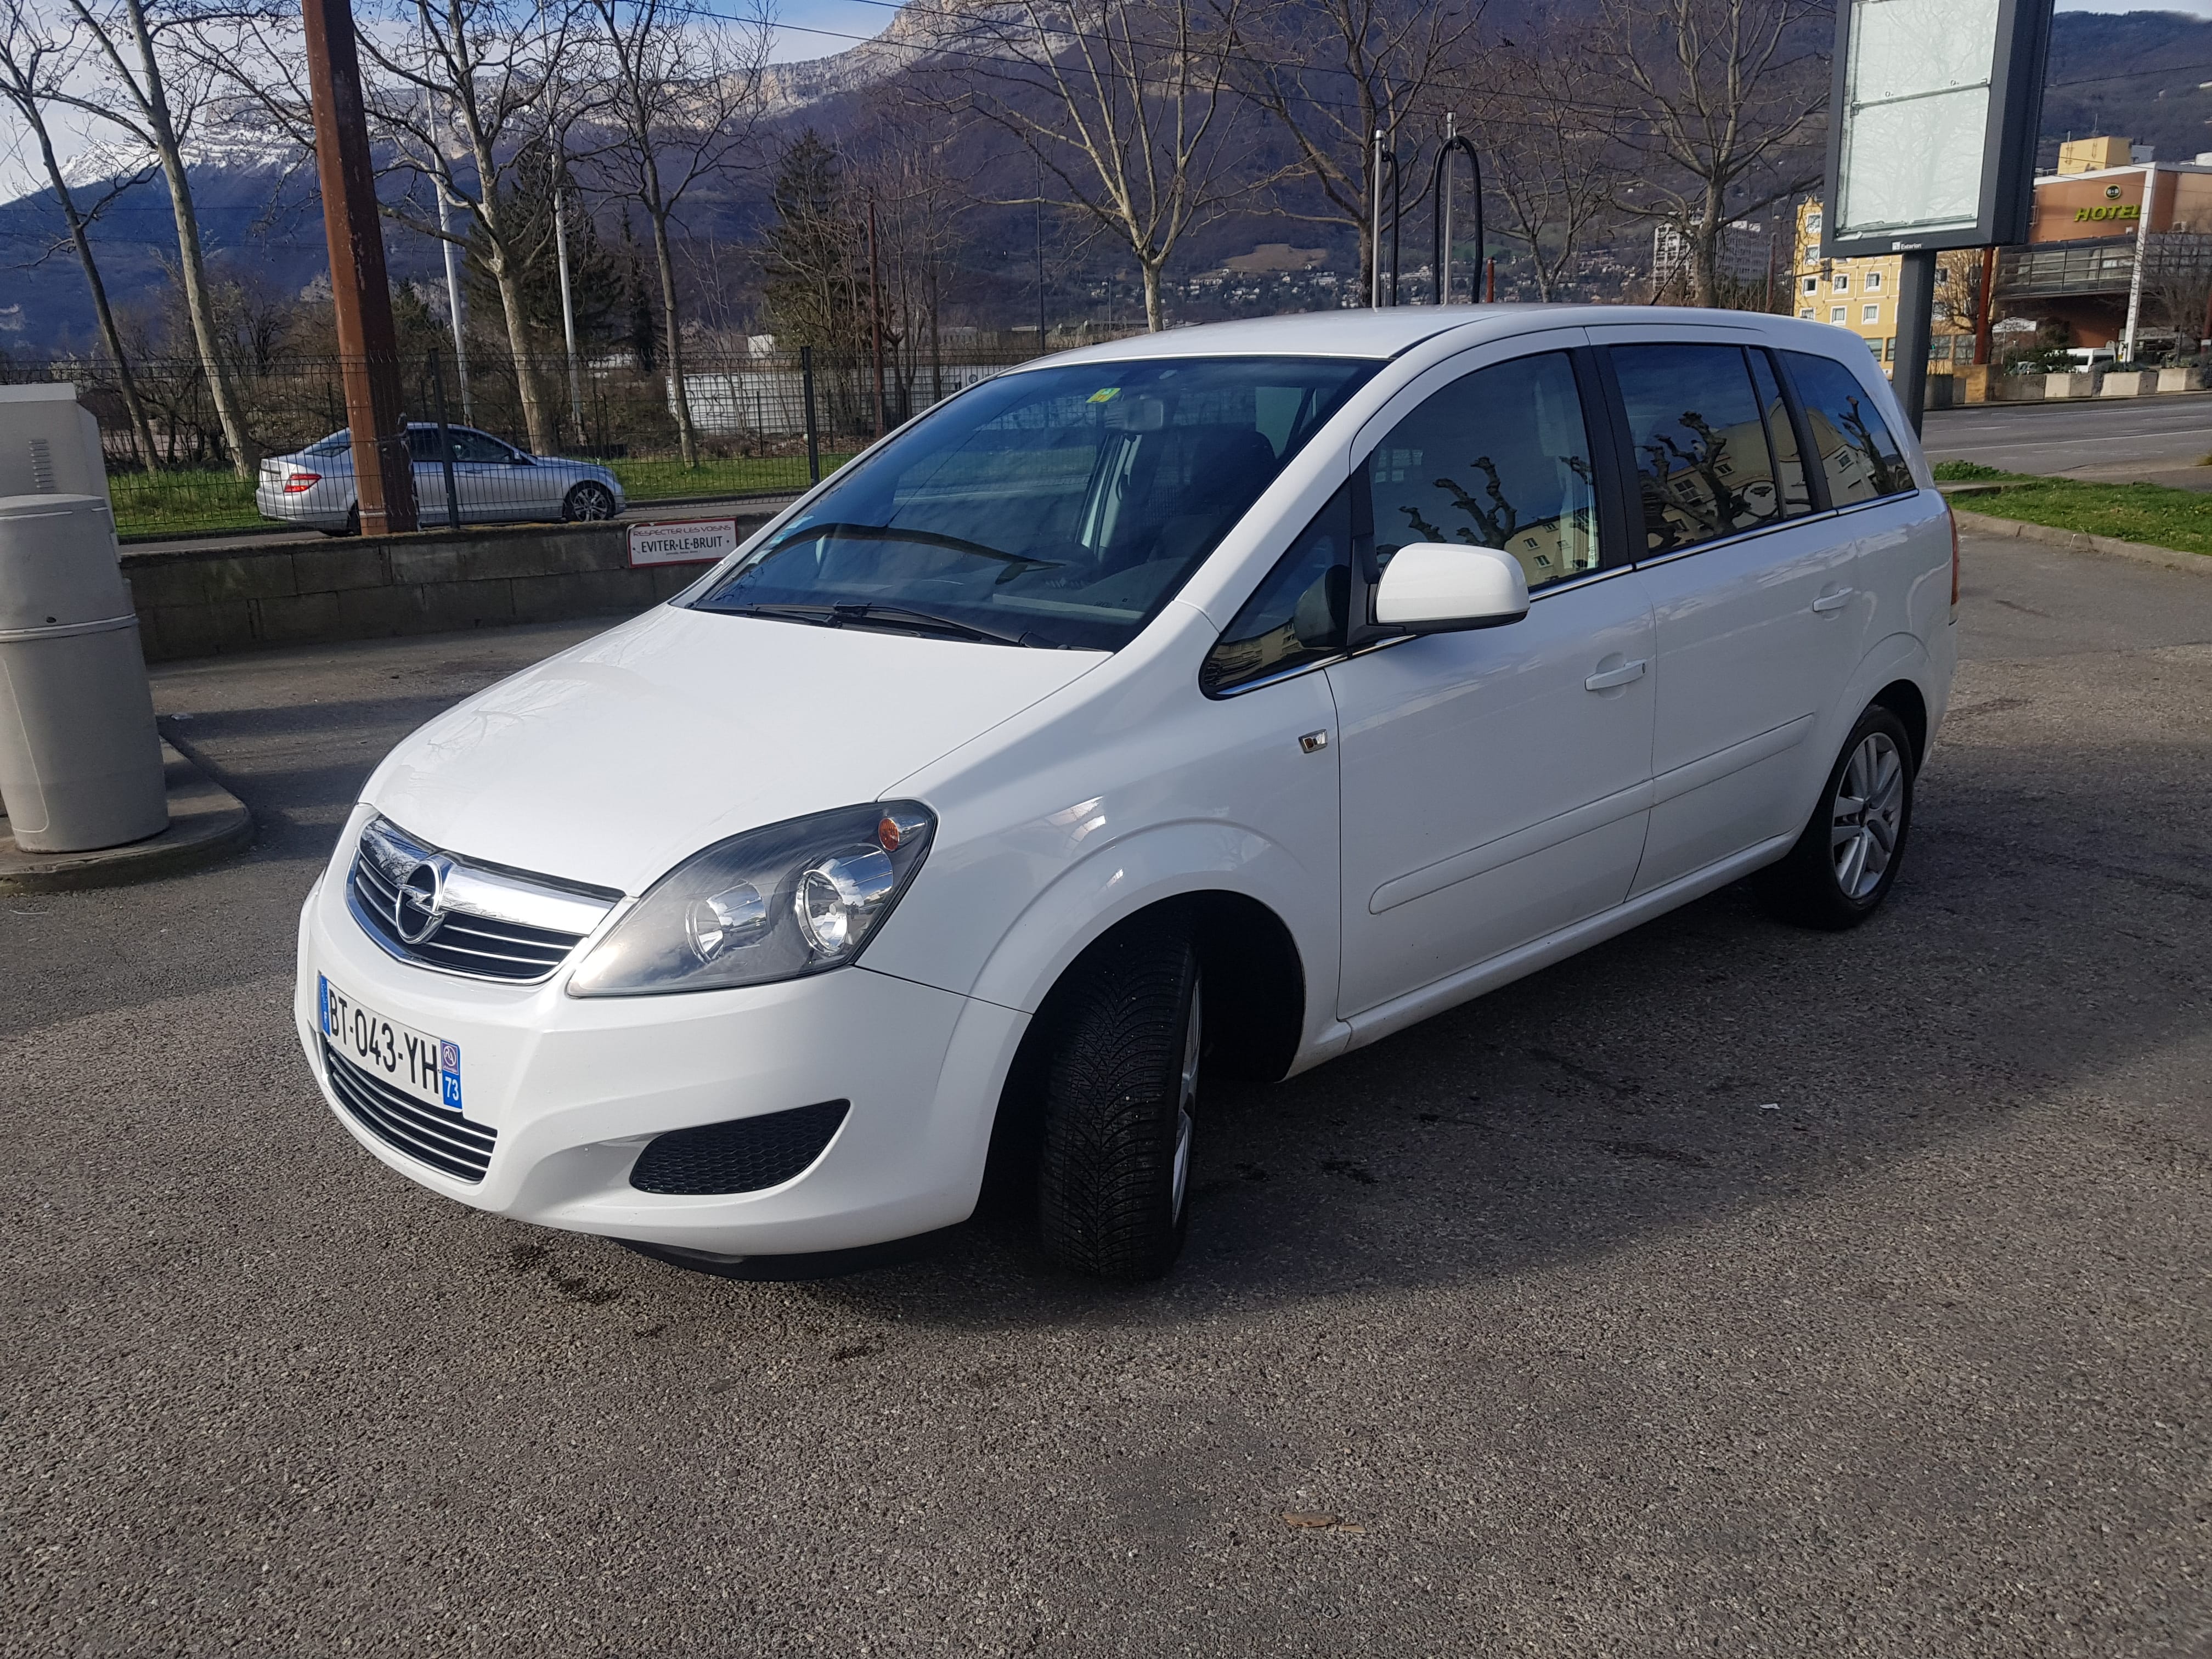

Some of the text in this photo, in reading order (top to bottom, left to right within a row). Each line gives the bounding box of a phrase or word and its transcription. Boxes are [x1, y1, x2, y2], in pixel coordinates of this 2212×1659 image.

[2073, 205, 2140, 222] HOTEL
[633, 528, 682, 537] RESPECTER
[329, 988, 439, 1094] BT-043-YH
[445, 1076, 459, 1101] 73
